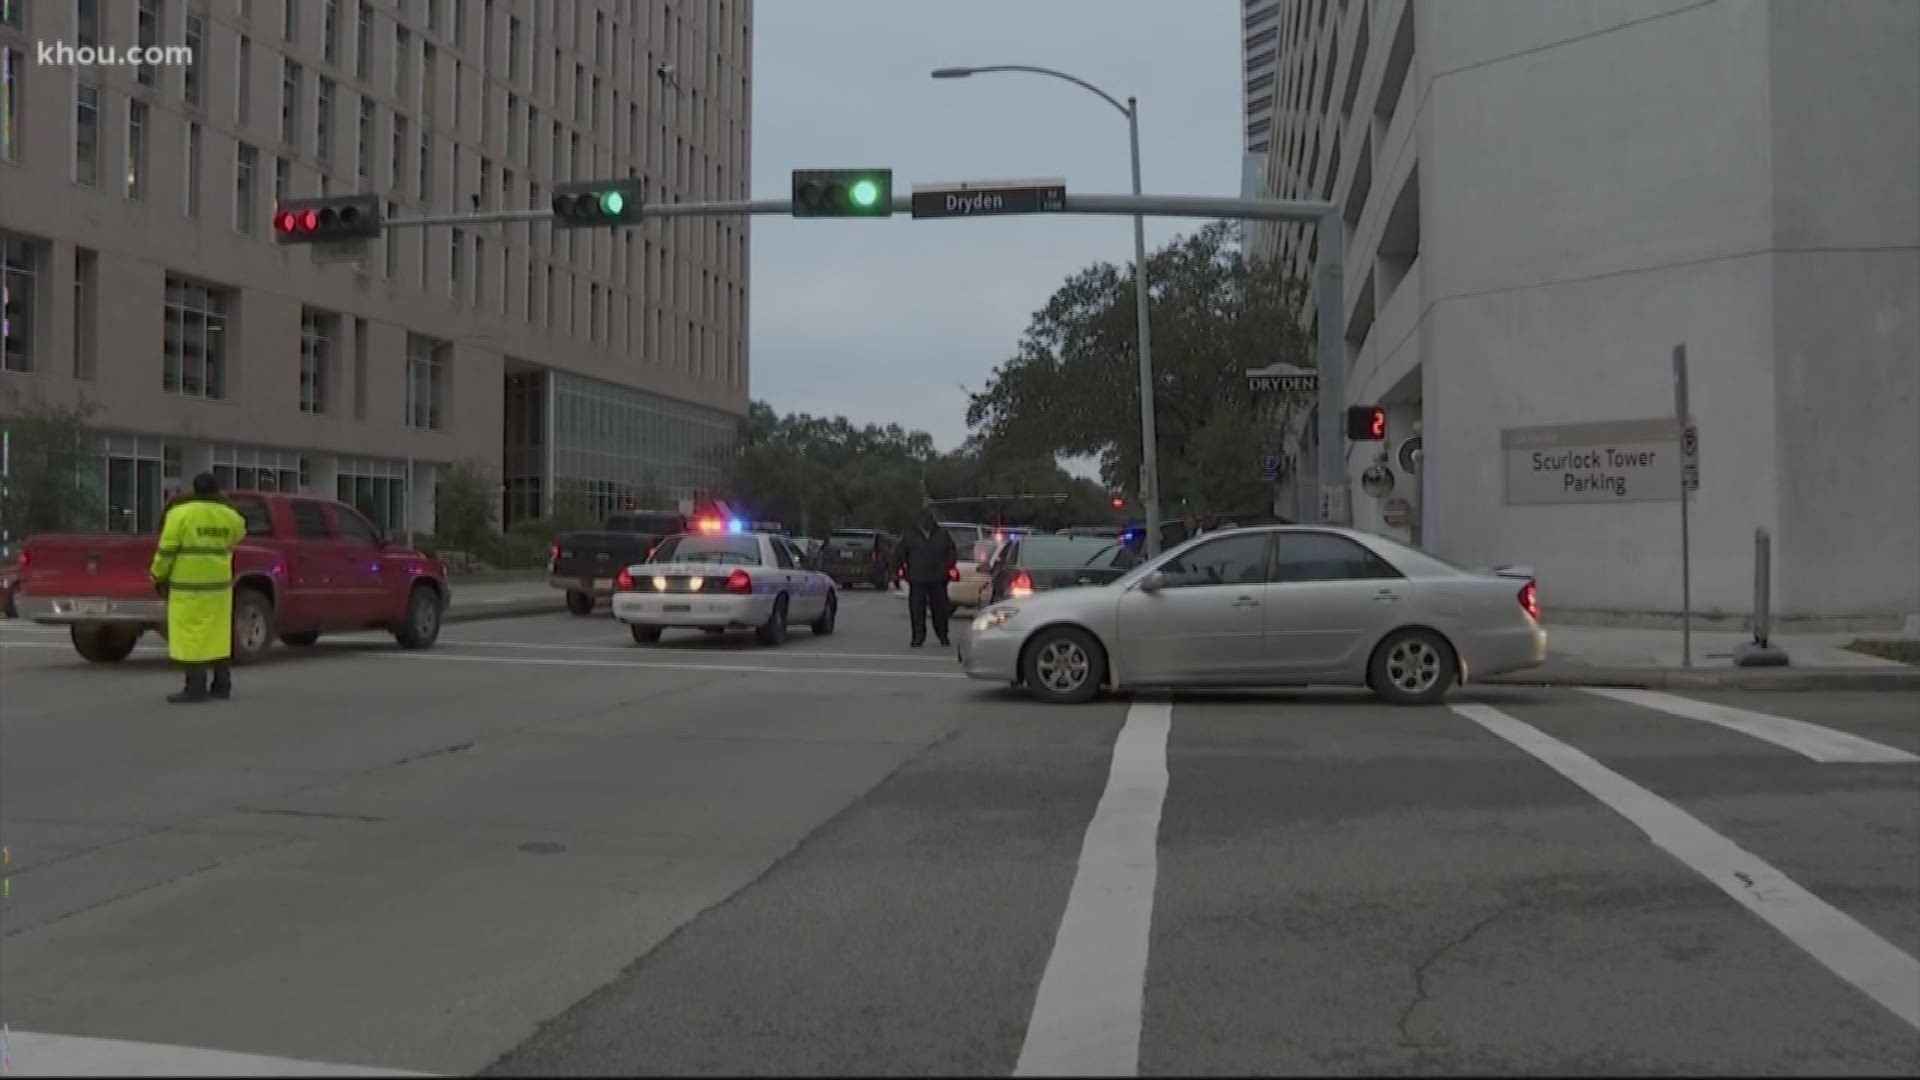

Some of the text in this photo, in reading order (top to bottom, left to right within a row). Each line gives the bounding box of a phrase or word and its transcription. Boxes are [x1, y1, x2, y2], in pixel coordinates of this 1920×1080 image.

[946, 190, 1002, 213] Dryden
[1250, 377, 1315, 391] DRYDEN
[1371, 411, 1385, 437] 2
[1532, 448, 1656, 471] Scurlock Tower
[1563, 472, 1627, 497] Parking
